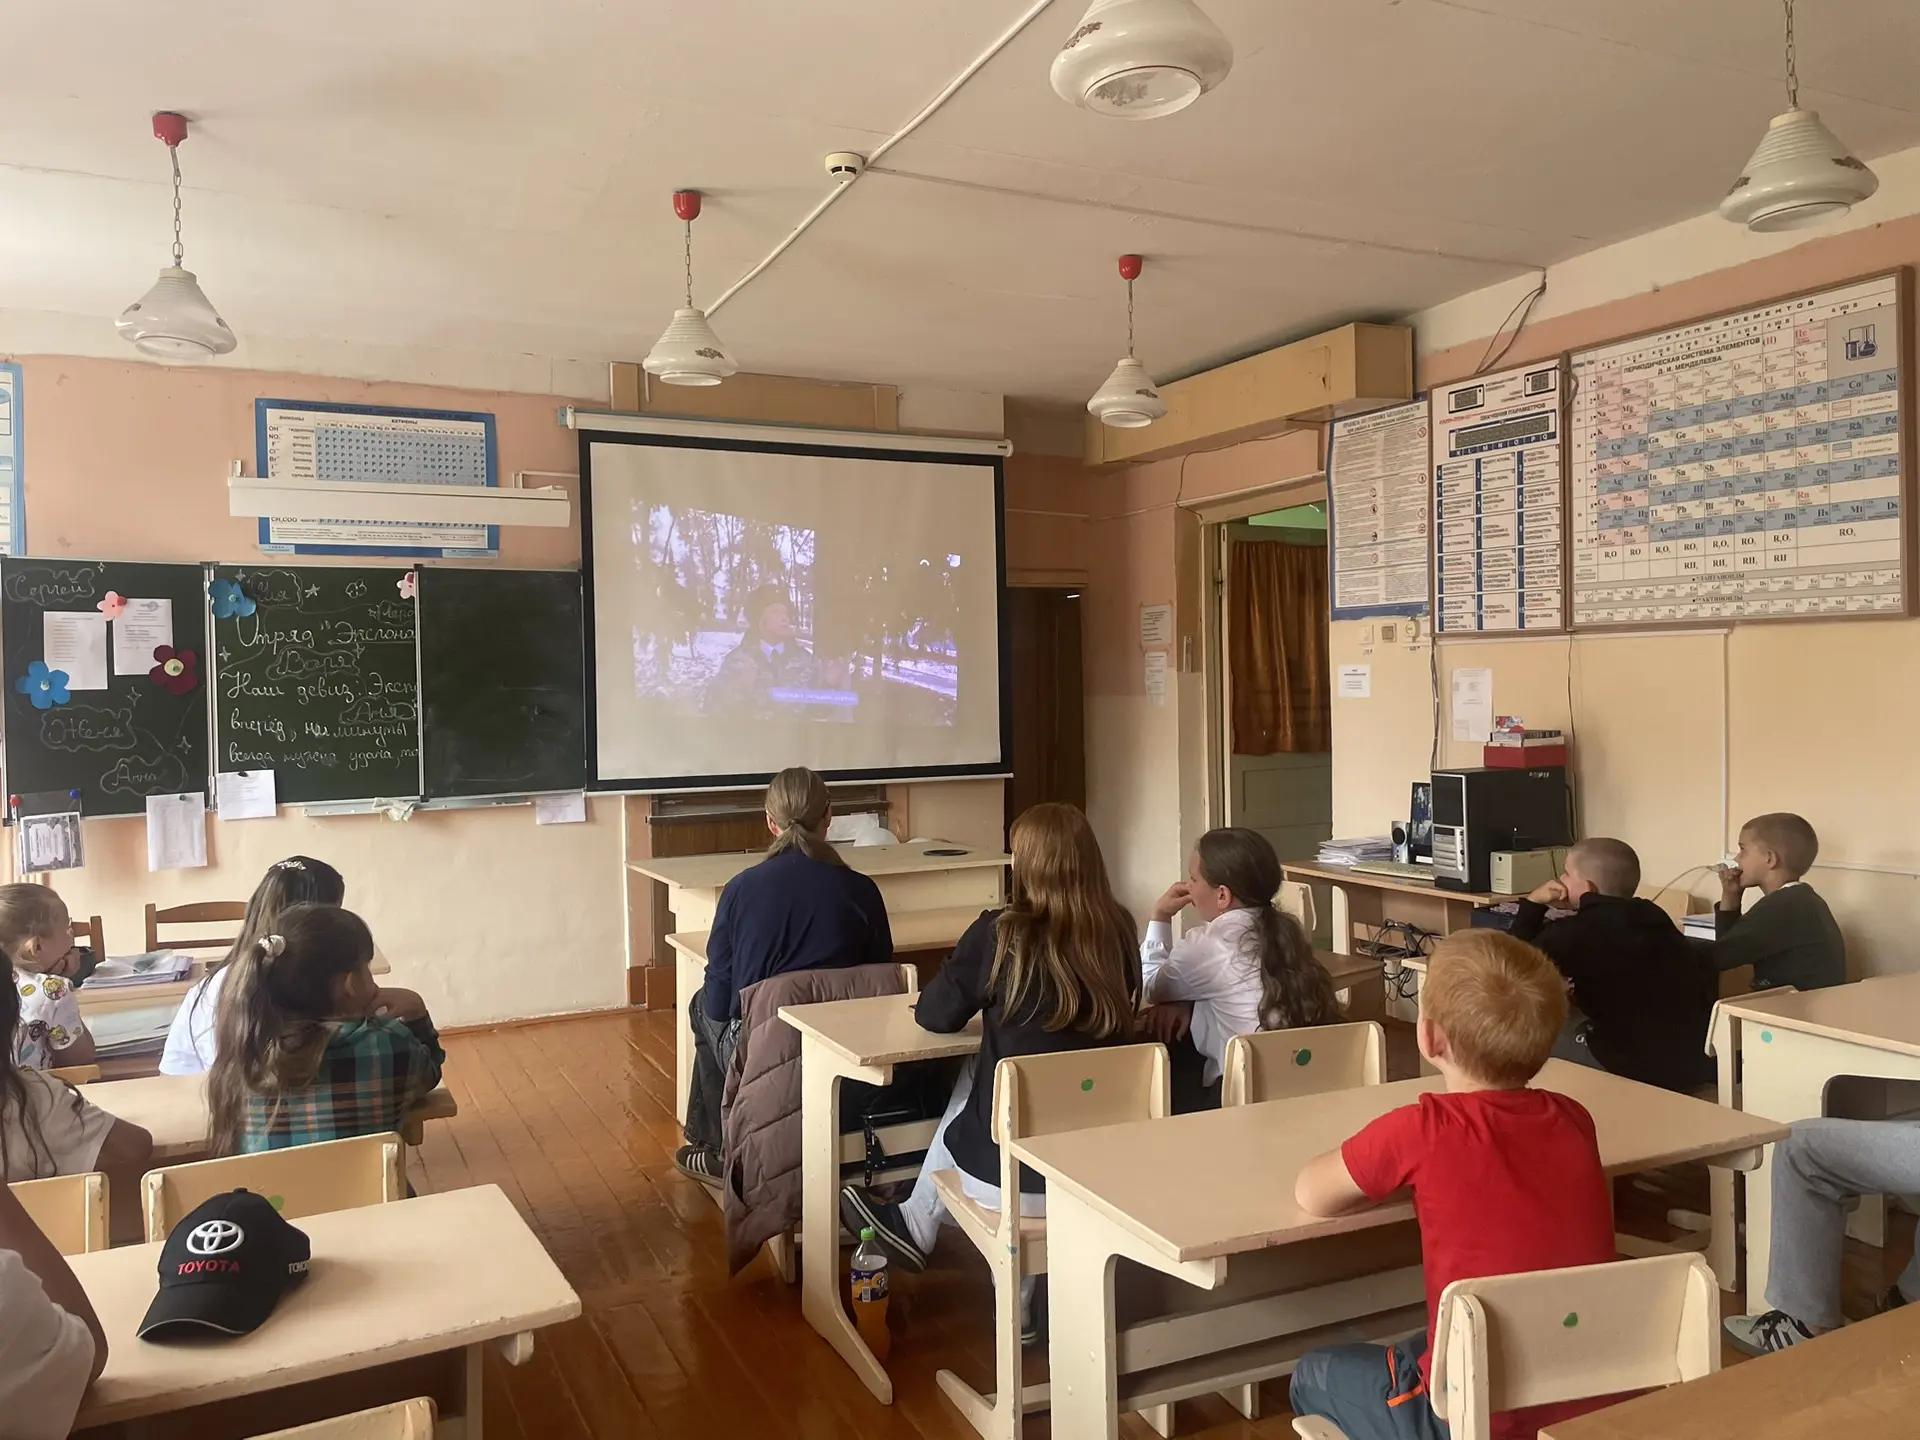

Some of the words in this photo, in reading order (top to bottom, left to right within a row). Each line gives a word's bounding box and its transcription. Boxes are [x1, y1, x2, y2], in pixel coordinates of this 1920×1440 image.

[1723, 300, 1814, 327] ЭЛЕМЕНТОВ
[1624, 356, 1680, 373] ПЕРИОДИЧЕСКАЯ
[1681, 348, 1714, 361] СИСТЕМА
[1715, 337, 1760, 353] ЭЛЕМЕНТОВ
[1675, 355, 1722, 370] МЕНДЕЛЕЕВА
[1849, 380, 1861, 389] Co
[1480, 411, 1508, 420] ЗНАЧЕНИЯ
[1508, 403, 1546, 415] ПАРАМЕТРОВ
[1797, 410, 1808, 419] Kr
[1885, 416, 1897, 425] Pd
[1622, 423, 1632, 431] Ca
[1676, 431, 1686, 440] Ge
[1798, 491, 1810, 499] Rn
[1677, 506, 1687, 514] Pb
[1887, 501, 1898, 510] Ds
[1722, 519, 1733, 527] Db
[1630, 548, 1641, 556] RO
[1774, 554, 1787, 562] RH
[15, 575, 86, 603] Сергей
[236, 612, 314, 655] Отряд
[220, 671, 285, 698] Наш
[298, 677, 361, 703] девиз:
[229, 742, 274, 768] всегда
[177, 1260, 240, 1275] TOYOTA
